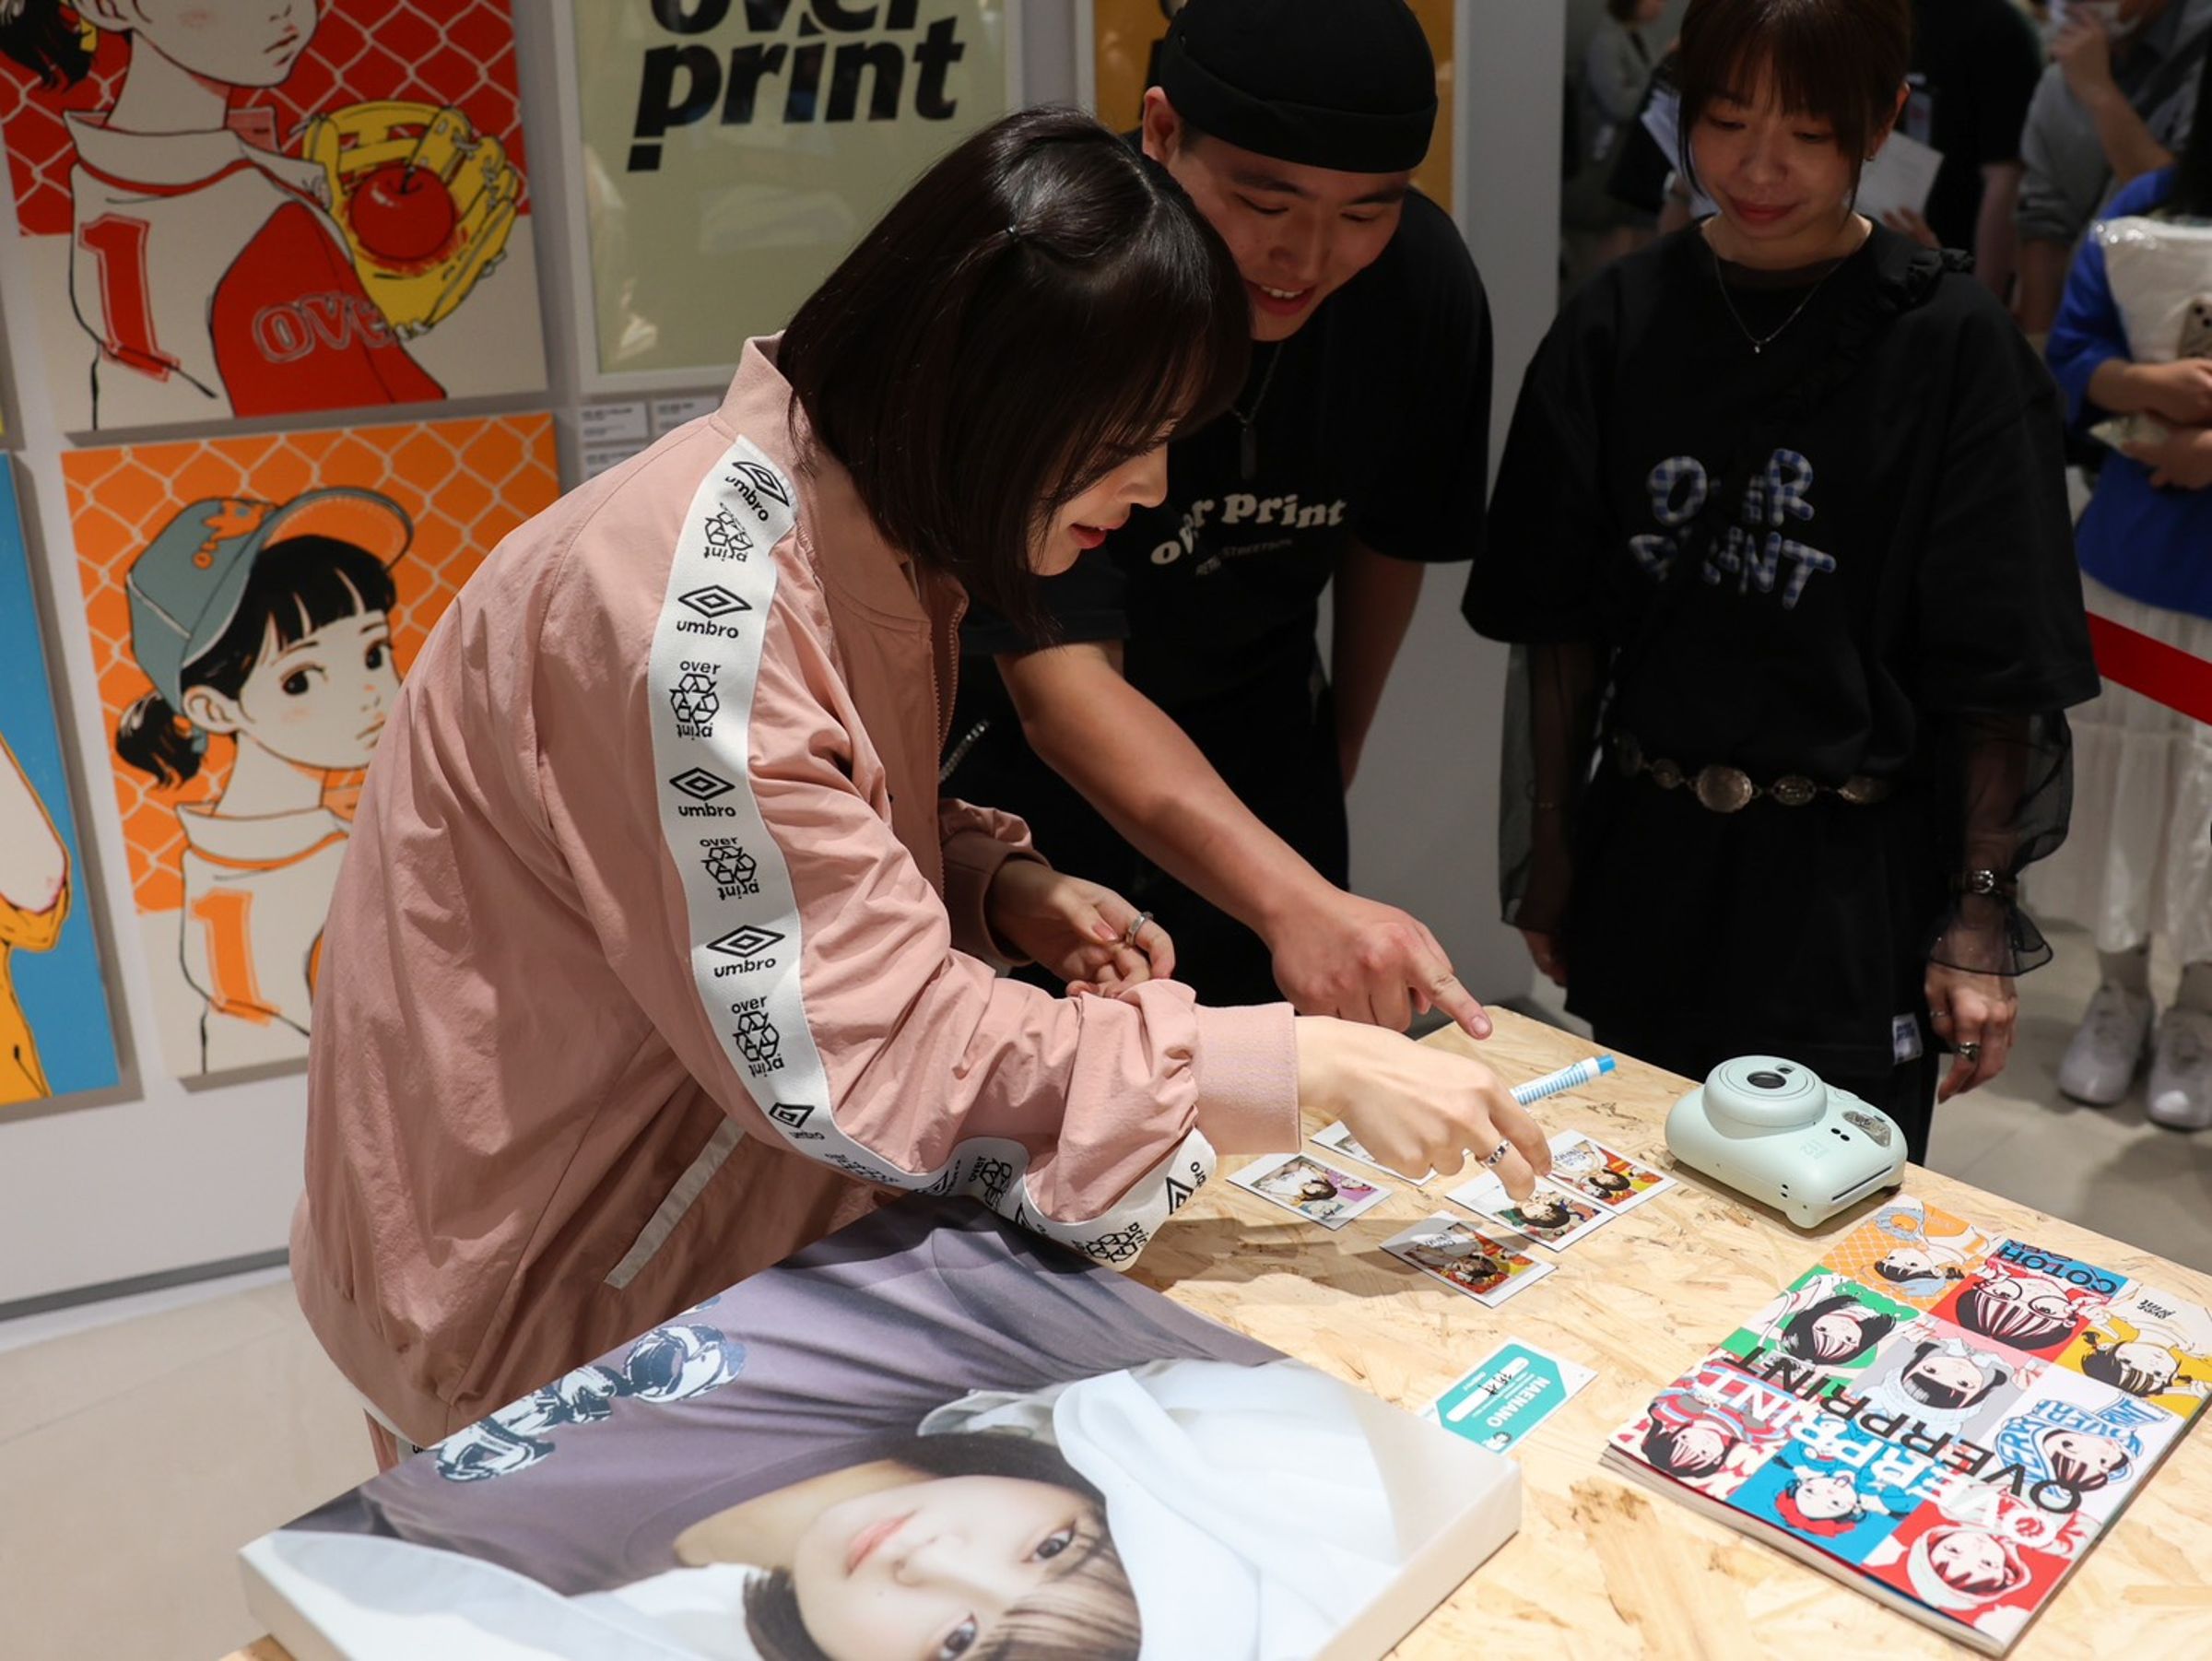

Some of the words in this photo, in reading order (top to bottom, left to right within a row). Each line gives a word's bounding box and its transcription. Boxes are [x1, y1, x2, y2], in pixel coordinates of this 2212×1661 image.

[627, 16, 966, 173] print
[724, 476, 770, 523] umbro
[703, 546, 748, 563] print
[677, 619, 739, 639] umbro
[679, 660, 722, 675] over
[676, 722, 714, 741] print
[678, 803, 736, 818] umbro
[700, 836, 738, 847] over
[717, 878, 760, 901] print
[713, 957, 777, 978] umbro
[731, 995, 768, 1015] over
[748, 1053, 785, 1078] print
[1723, 1346, 2082, 1514] OVERPRINT
